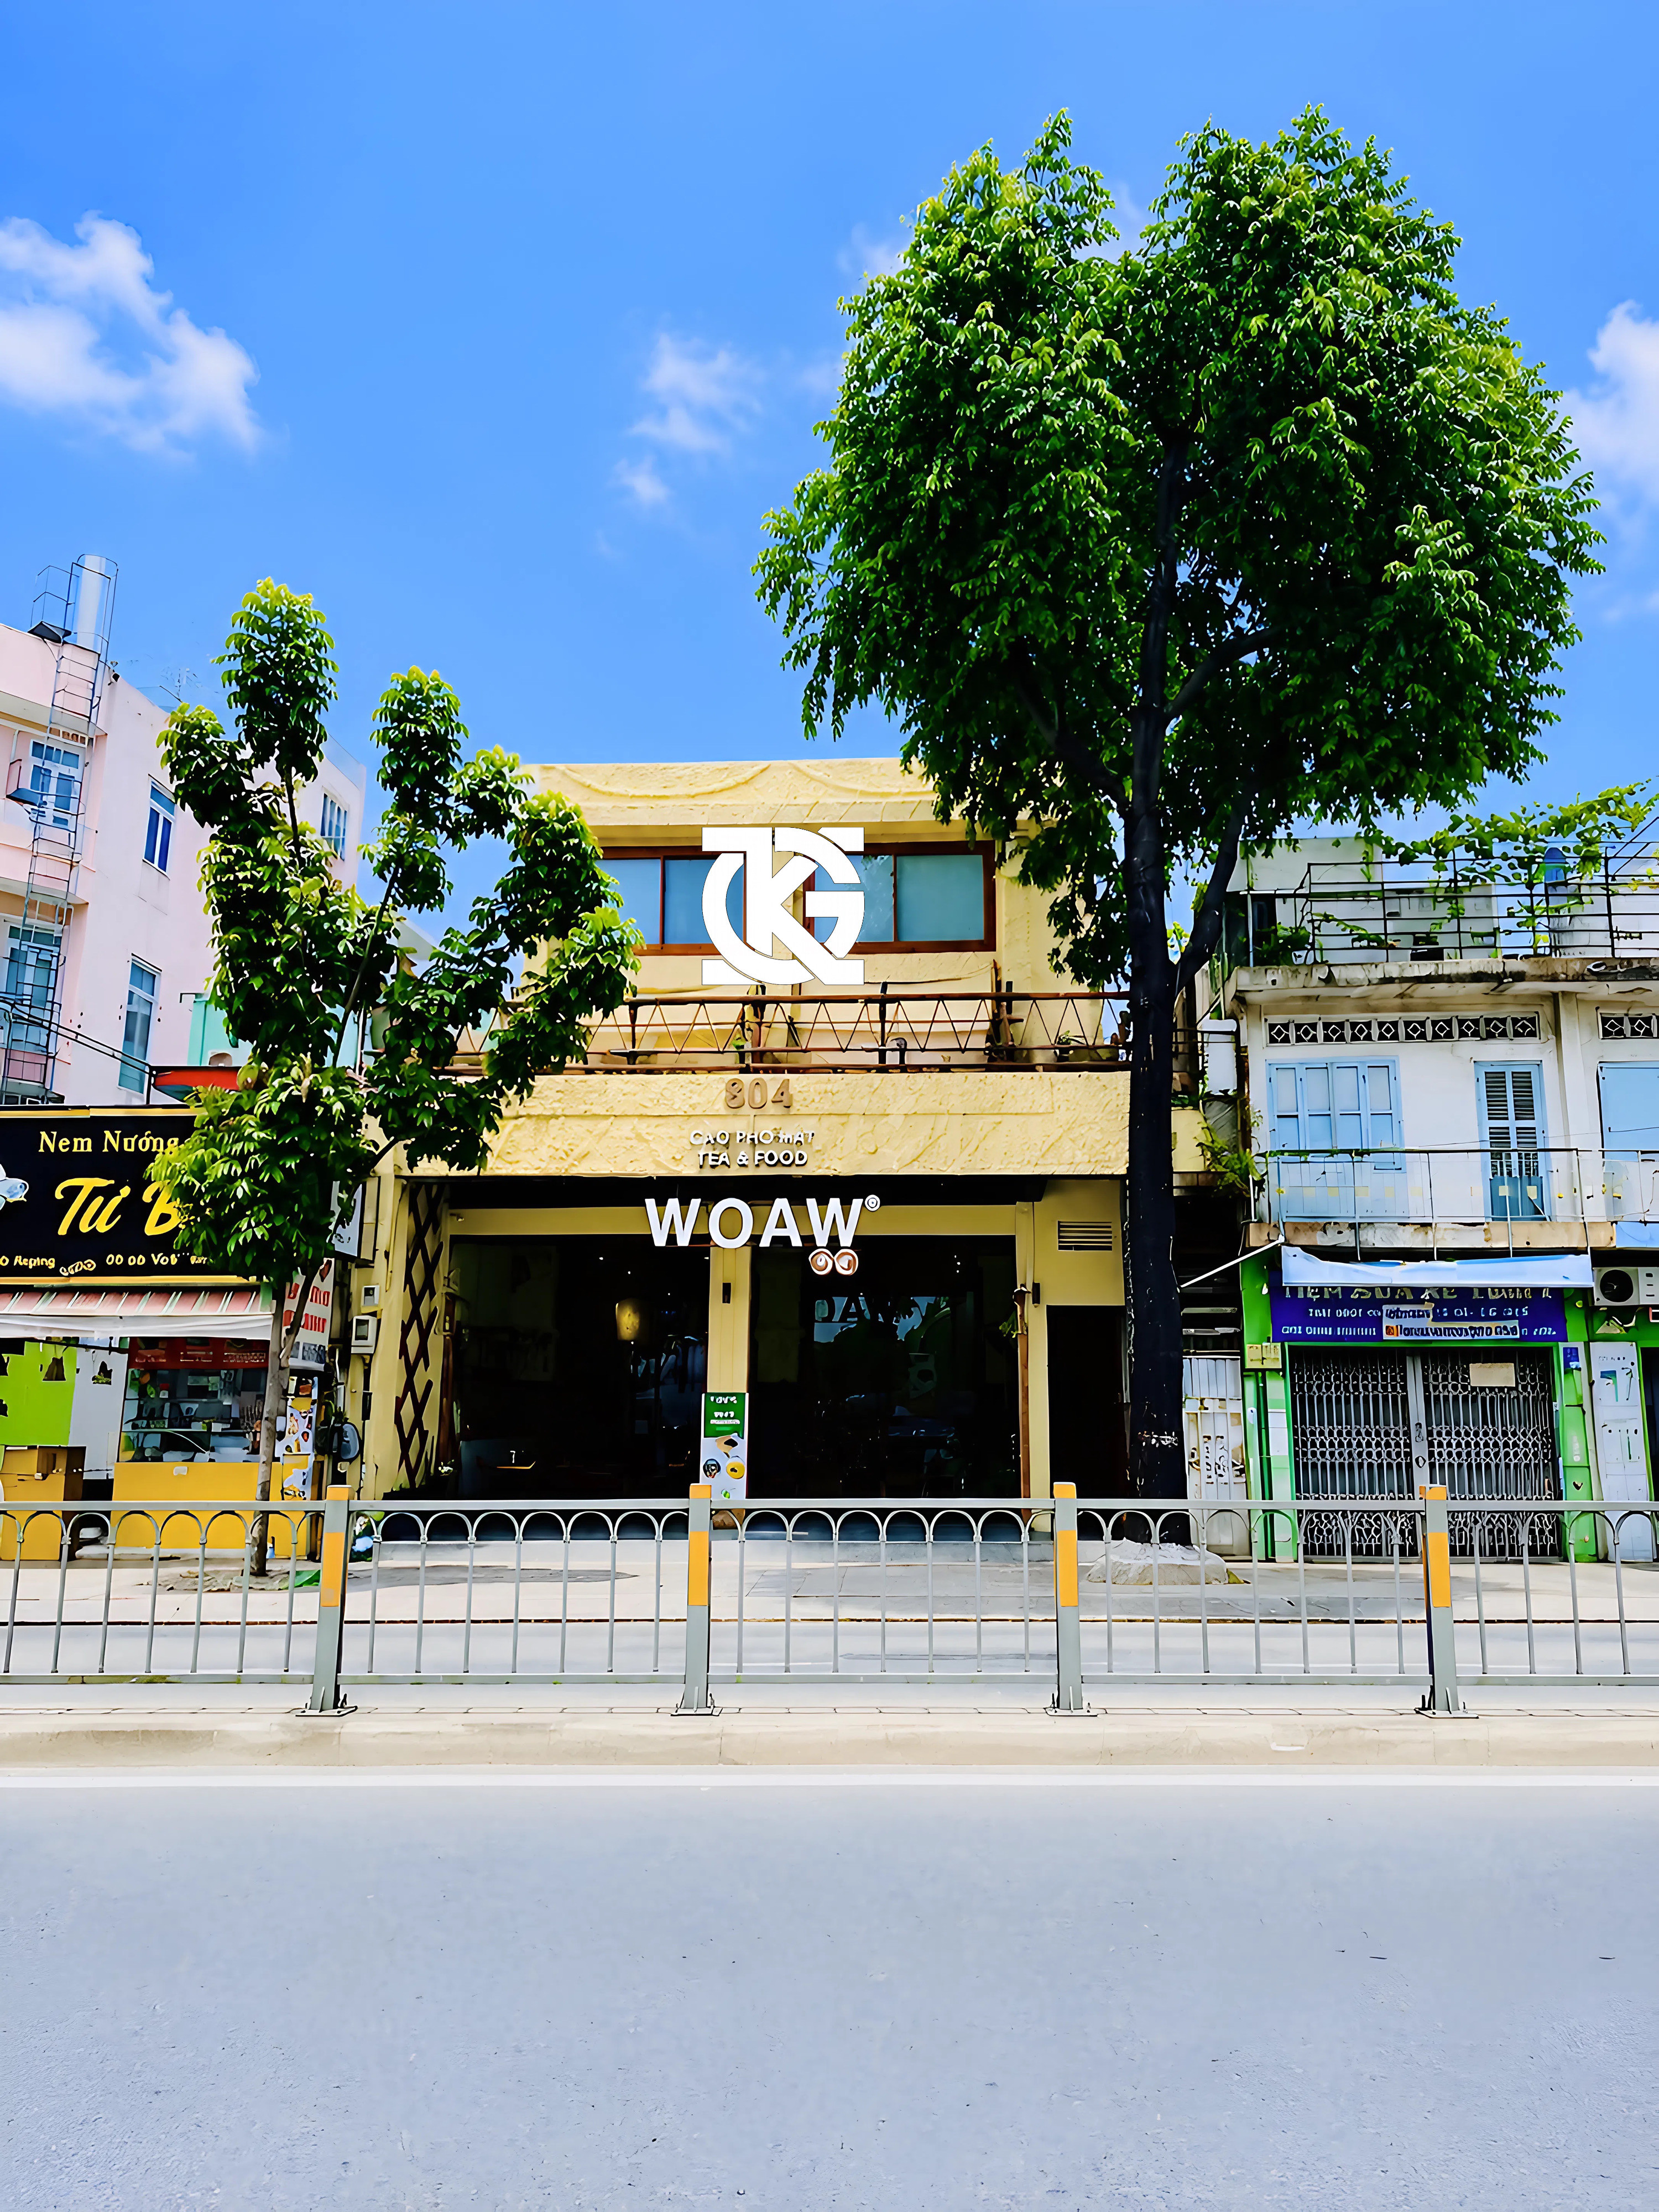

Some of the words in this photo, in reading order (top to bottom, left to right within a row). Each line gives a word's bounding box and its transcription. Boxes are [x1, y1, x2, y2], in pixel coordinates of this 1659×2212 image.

[725, 1078, 792, 1109] 804
[38, 1131, 92, 1152] Nem
[698, 1152, 730, 1168] TEA
[755, 1150, 807, 1167] FOOD
